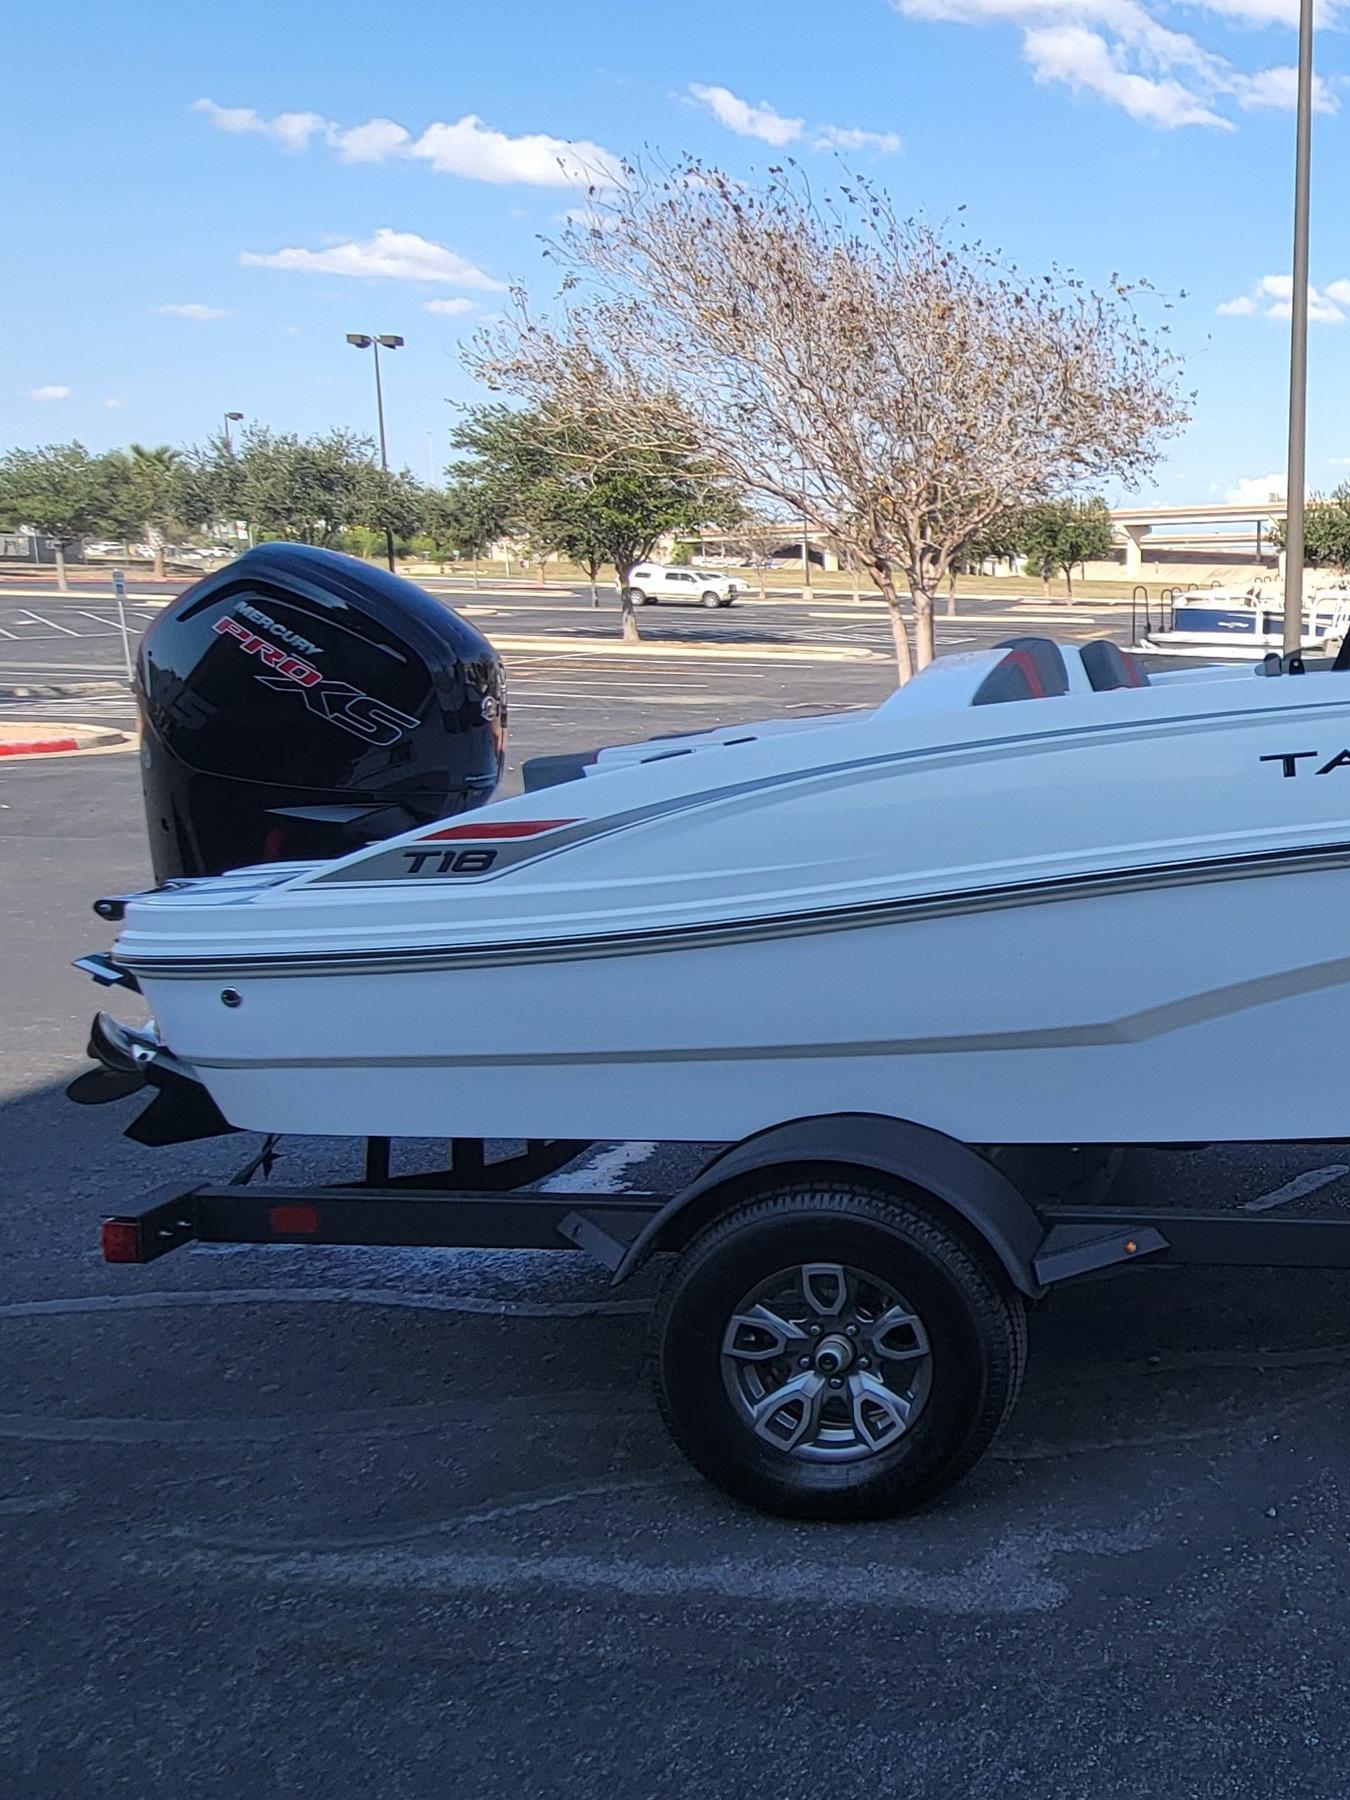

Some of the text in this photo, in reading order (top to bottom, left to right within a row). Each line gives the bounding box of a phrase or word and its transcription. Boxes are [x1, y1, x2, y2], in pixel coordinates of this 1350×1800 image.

[212, 616, 323, 688] PRO
[233, 601, 325, 655] MERCURY
[254, 676, 421, 746] XS
[403, 849, 497, 873] T18
